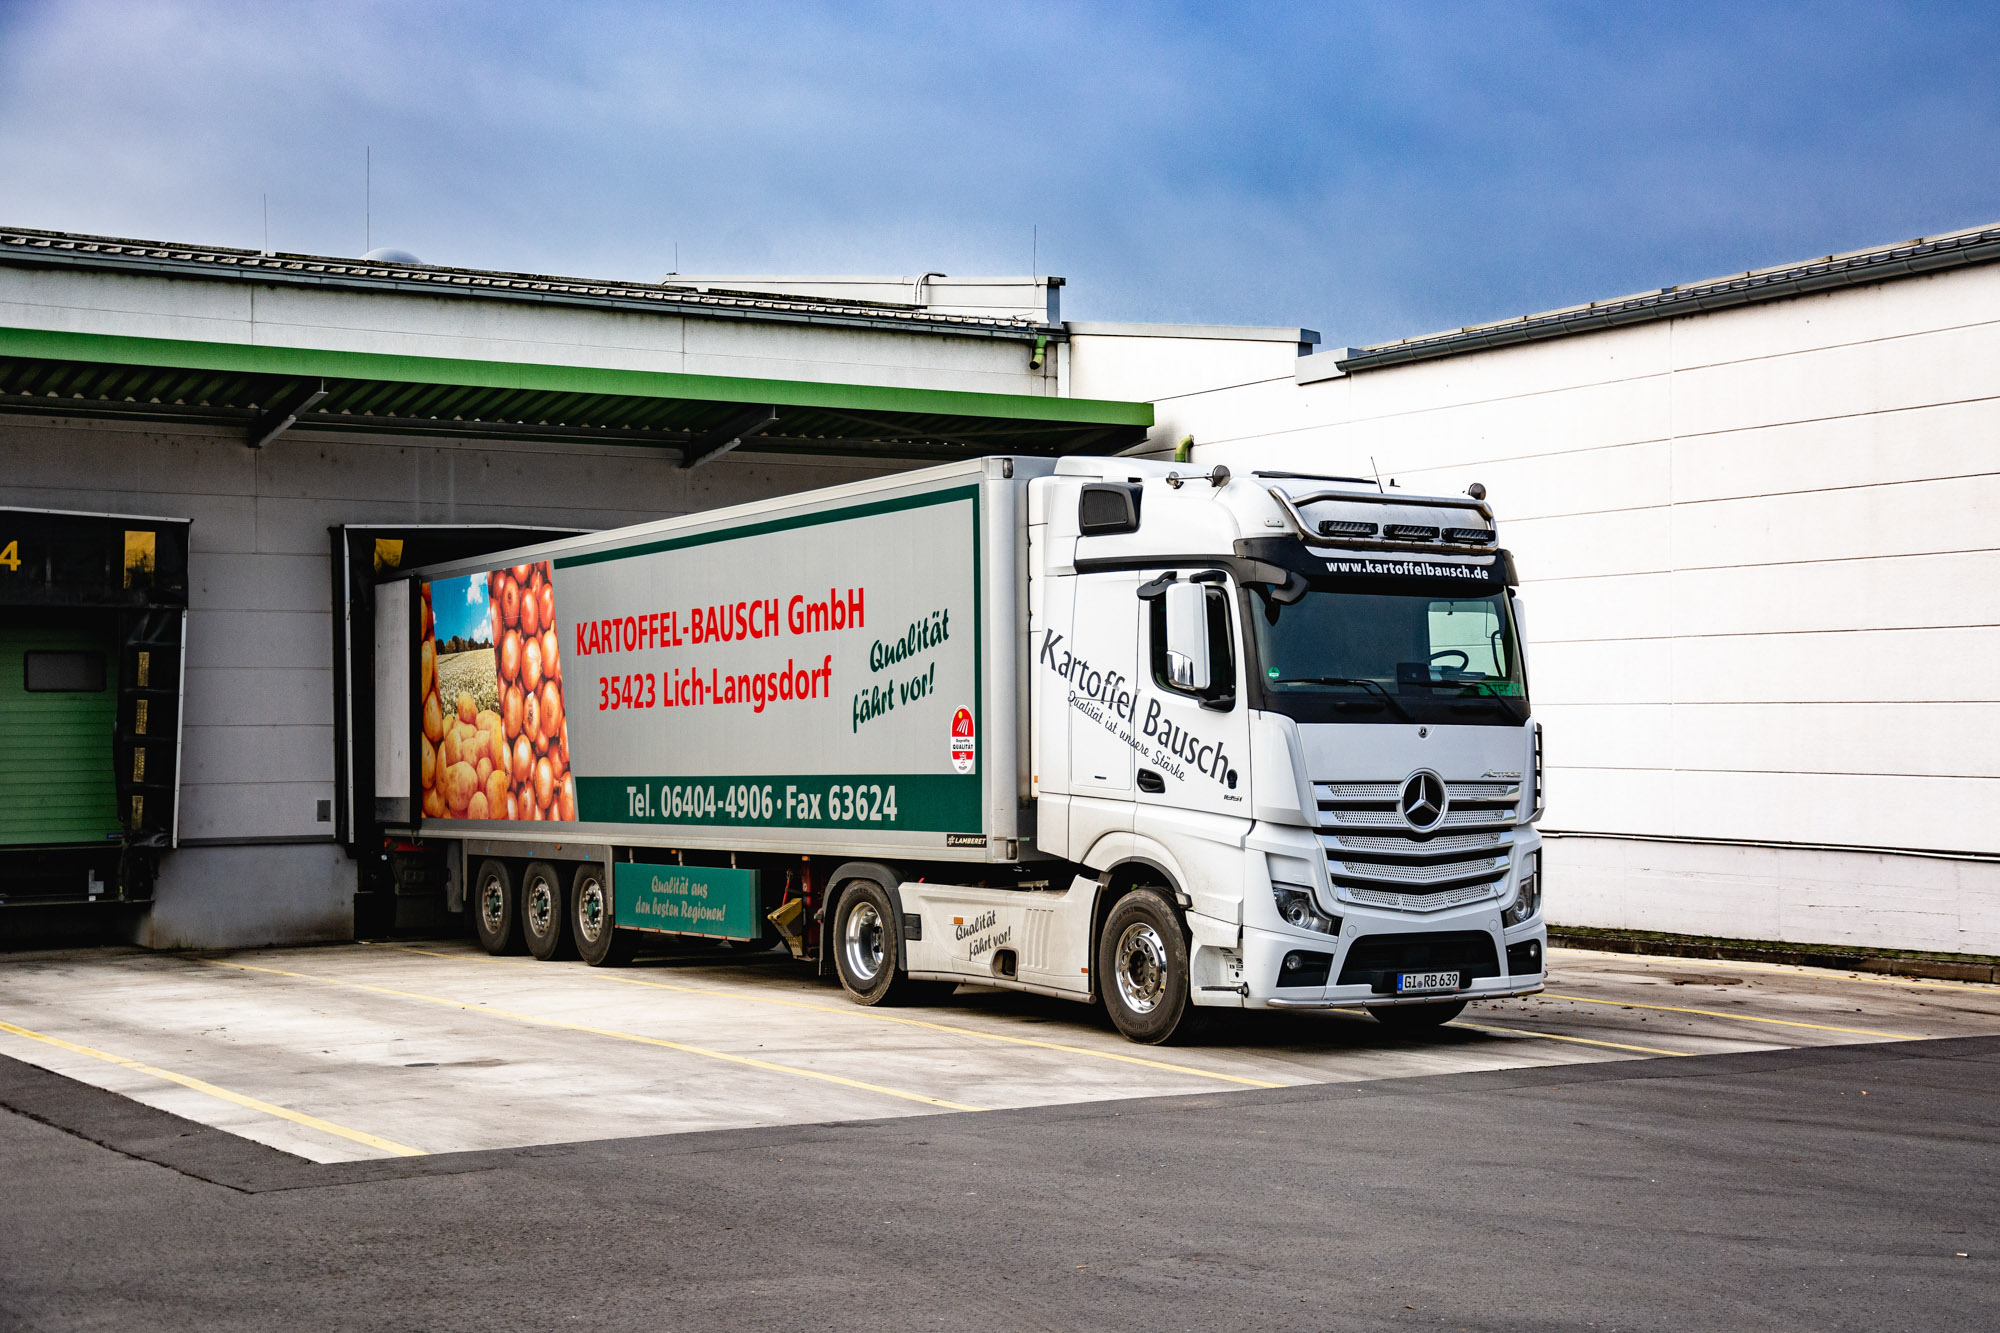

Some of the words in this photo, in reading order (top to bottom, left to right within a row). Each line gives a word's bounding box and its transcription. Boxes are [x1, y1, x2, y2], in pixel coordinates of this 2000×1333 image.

[1326, 560, 1489, 580] www.kartoffelbausch.de
[576, 597, 779, 656] KARTOFFEL-BAUSCH
[788, 587, 864, 635] GmbH
[870, 608, 949, 672] Qualität
[599, 673, 656, 711] 35423
[663, 654, 832, 713] Lich-Langsdorf
[853, 679, 894, 733] fährt
[900, 662, 934, 705] vor!
[1040, 628, 1142, 724] Kartoffel
[1143, 697, 1229, 785] Bausch
[1068, 690, 1103, 724] Qualität
[1105, 716, 1118, 734] ist
[1119, 730, 1149, 757] unsere
[1152, 750, 1185, 781] Stärke
[627, 784, 655, 817] Tel.
[661, 785, 773, 819] 06404-4906
[786, 785, 822, 820] Fax
[828, 785, 898, 822] 63624
[955, 837, 986, 845] LAMBERET
[651, 875, 689, 895] Qualität
[691, 883, 708, 899] aus
[635, 896, 650, 914] den
[652, 897, 679, 918] besten
[681, 900, 726, 924] Regionen!
[955, 909, 996, 941] Qualität
[969, 934, 992, 962] fährt
[993, 925, 1011, 947] vor!
[1404, 975, 1417, 988] GI
[1423, 974, 1437, 988] RB
[1439, 973, 1458, 987] 639
